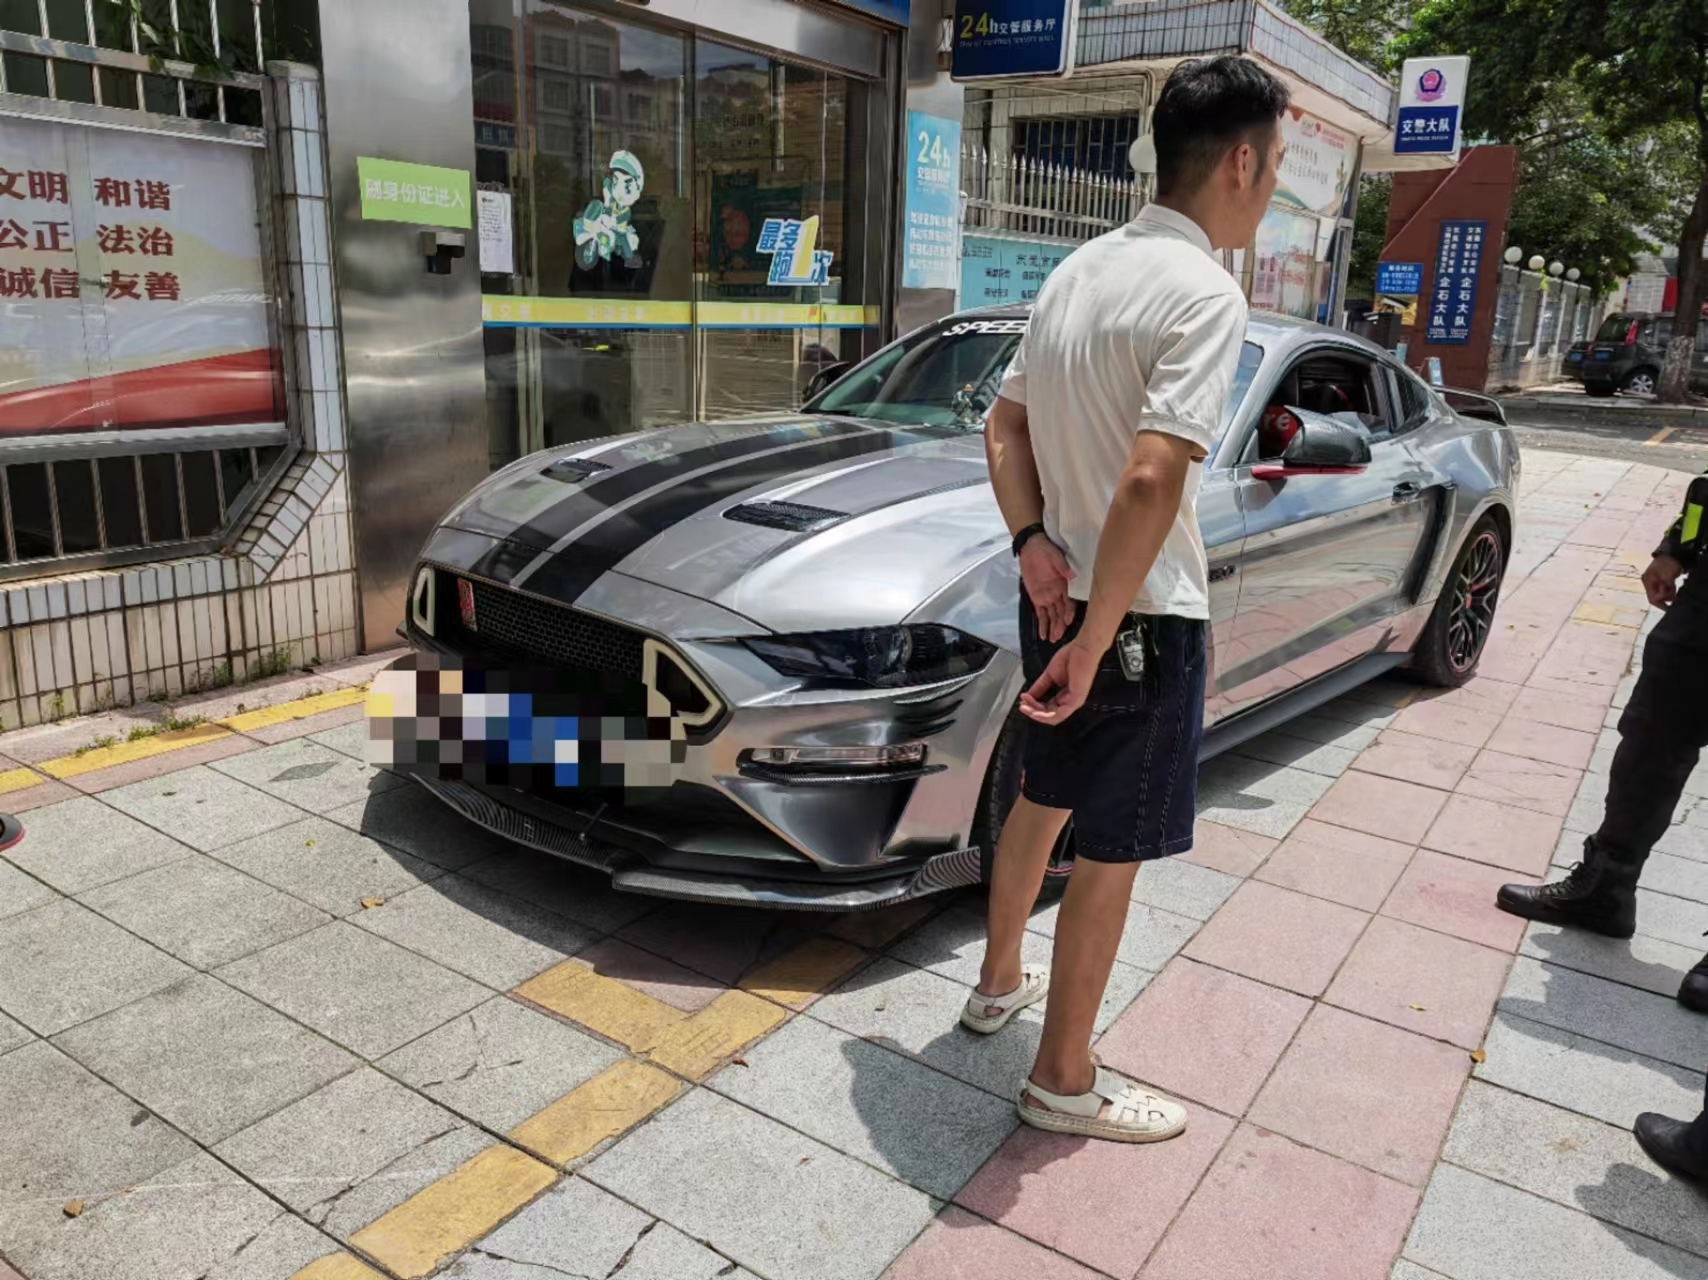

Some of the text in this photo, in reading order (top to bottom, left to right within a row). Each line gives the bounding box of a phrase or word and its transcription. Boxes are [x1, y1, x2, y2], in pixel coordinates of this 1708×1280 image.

[1402, 117, 1450, 134] 交警大队
[917, 130, 951, 168] 24h
[0, 168, 170, 211] 文明 和谐
[0, 219, 174, 256] 公正 法治
[0, 267, 180, 301] 诚信 友善
[1433, 276, 1451, 327] 企石大队
[1453, 276, 1473, 327] 企石大队
[942, 320, 1028, 336] SPEE
